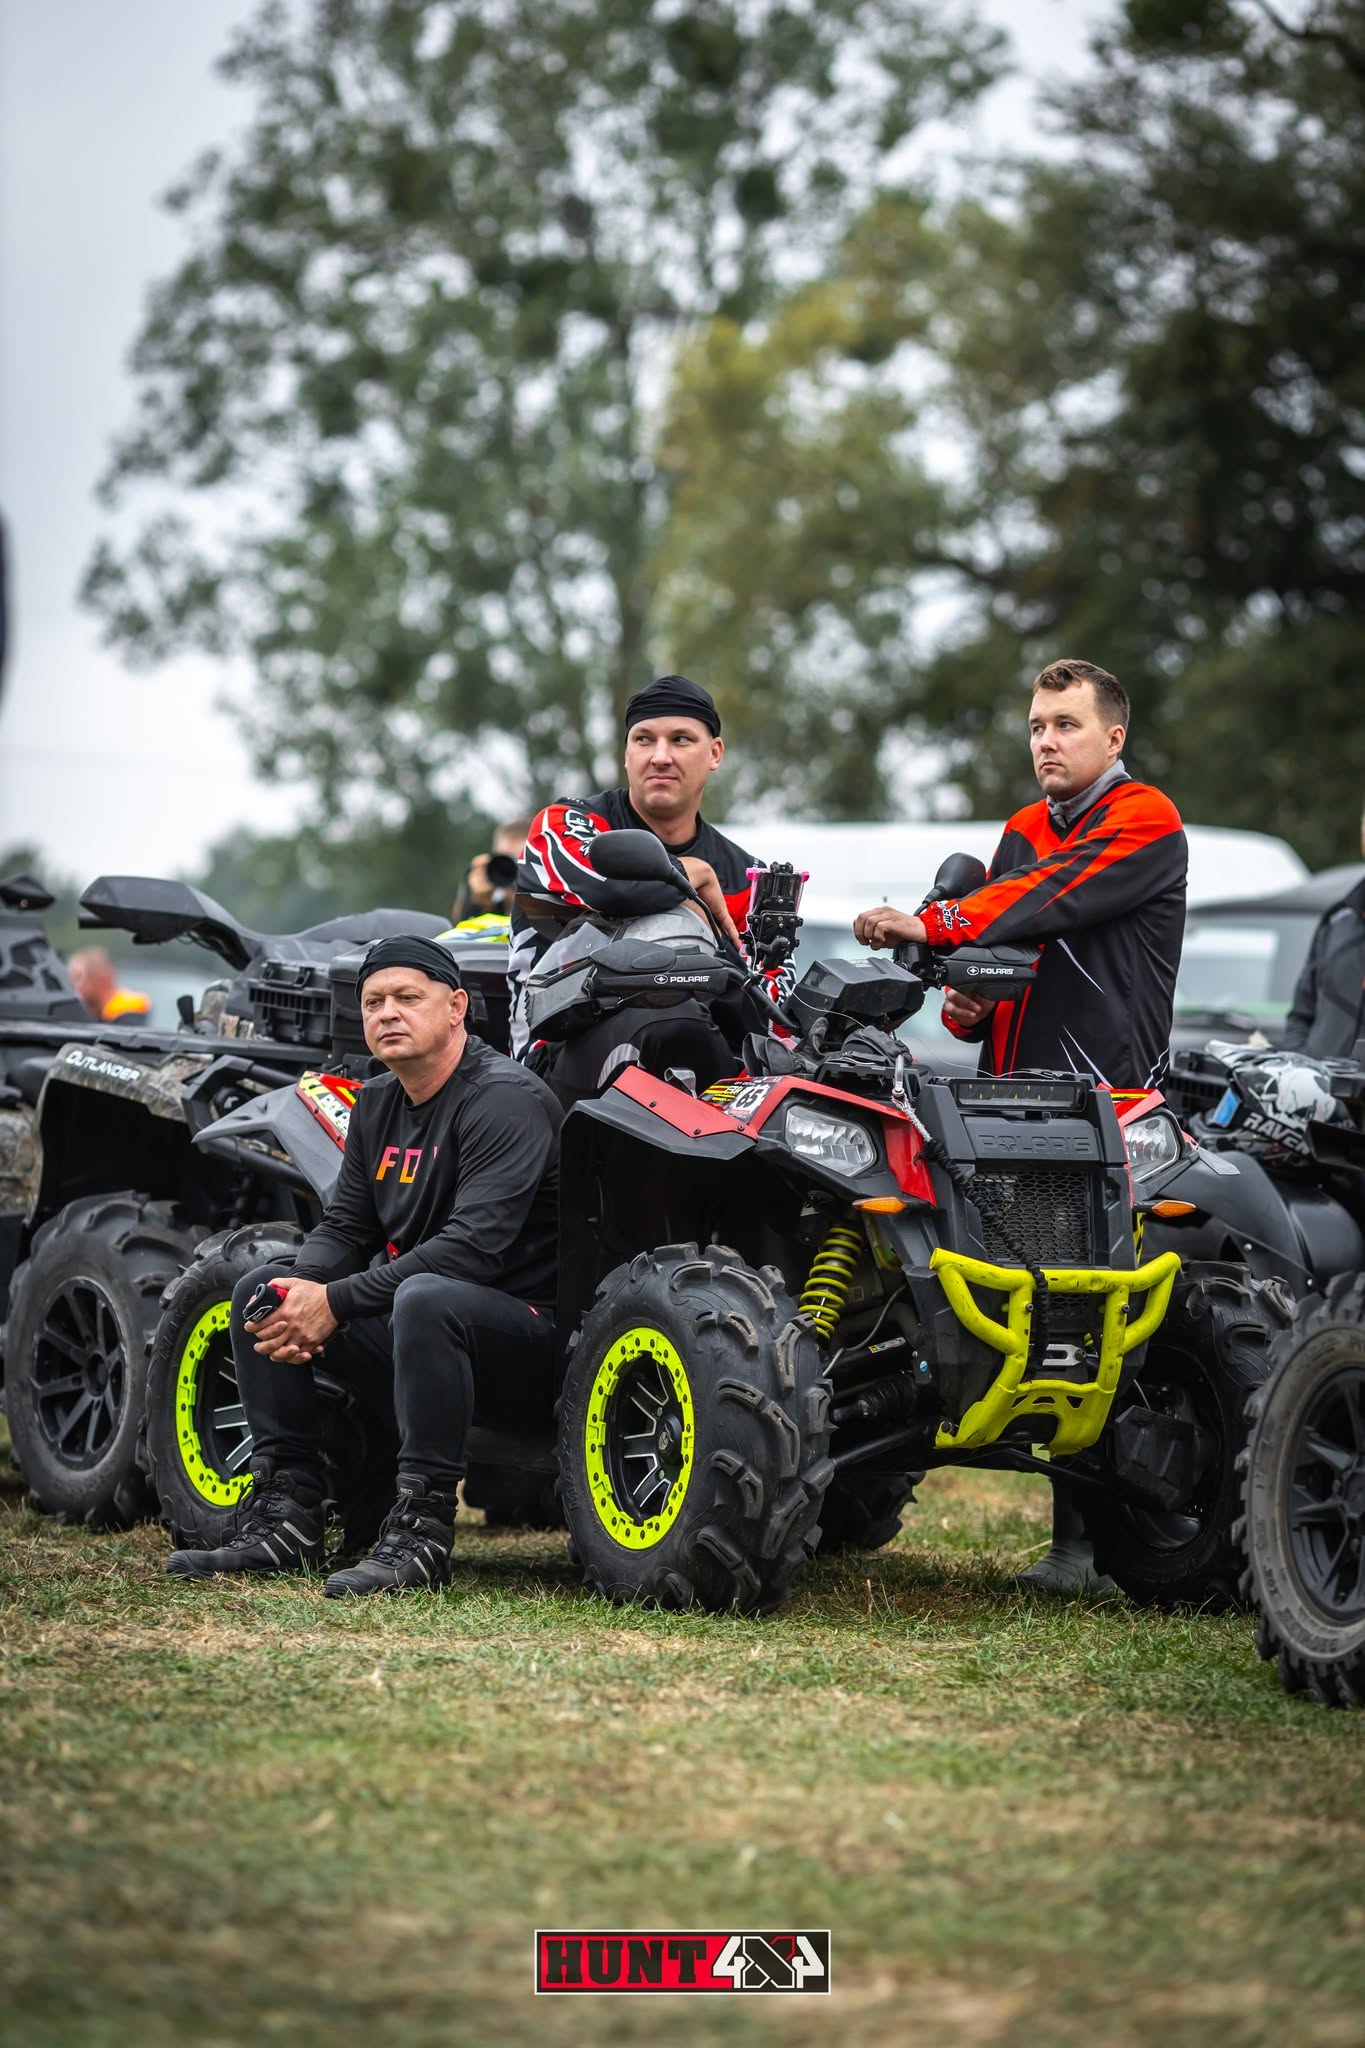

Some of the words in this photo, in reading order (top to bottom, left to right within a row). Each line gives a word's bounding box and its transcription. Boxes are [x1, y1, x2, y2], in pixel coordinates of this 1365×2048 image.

[669, 975, 710, 983] POLARIS
[980, 967, 1014, 975] POLARIS
[65, 1050, 140, 1081] OUTLANDER
[735, 1087, 764, 1108] 65
[978, 1134, 1093, 1154] POLARIS
[376, 1146, 438, 1183] FO
